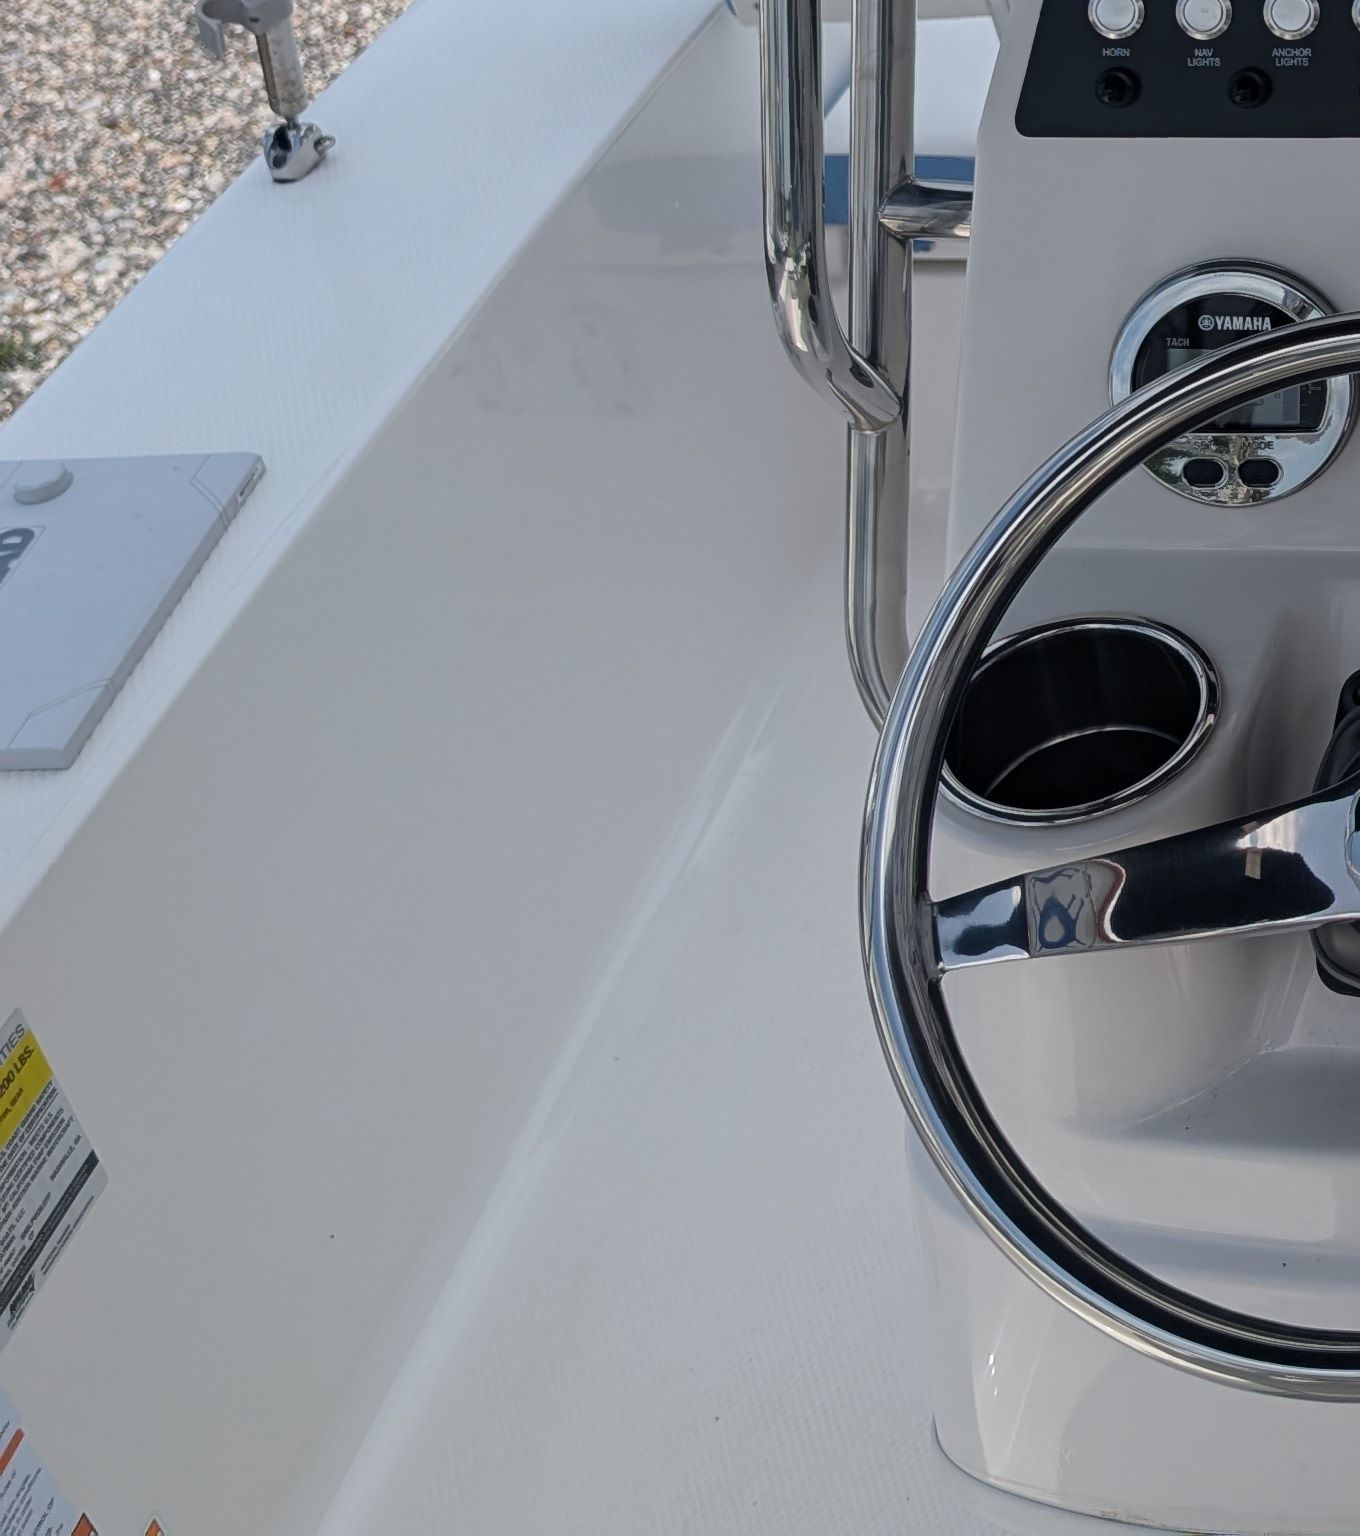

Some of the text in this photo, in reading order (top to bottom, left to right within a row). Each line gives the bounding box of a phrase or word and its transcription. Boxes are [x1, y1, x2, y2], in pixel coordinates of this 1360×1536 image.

[1102, 48, 1130, 57] HORN
[1194, 48, 1213, 57] NAV
[1271, 48, 1312, 57] ANCHOR
[1187, 58, 1220, 66] LIGHTS
[1275, 58, 1309, 66] LIGHTS
[1215, 317, 1272, 331] YAMAHA
[1166, 337, 1190, 346] TACH
[0, 1024, 25, 1065] TIES
[13, 1045, 35, 1074] LBS.
